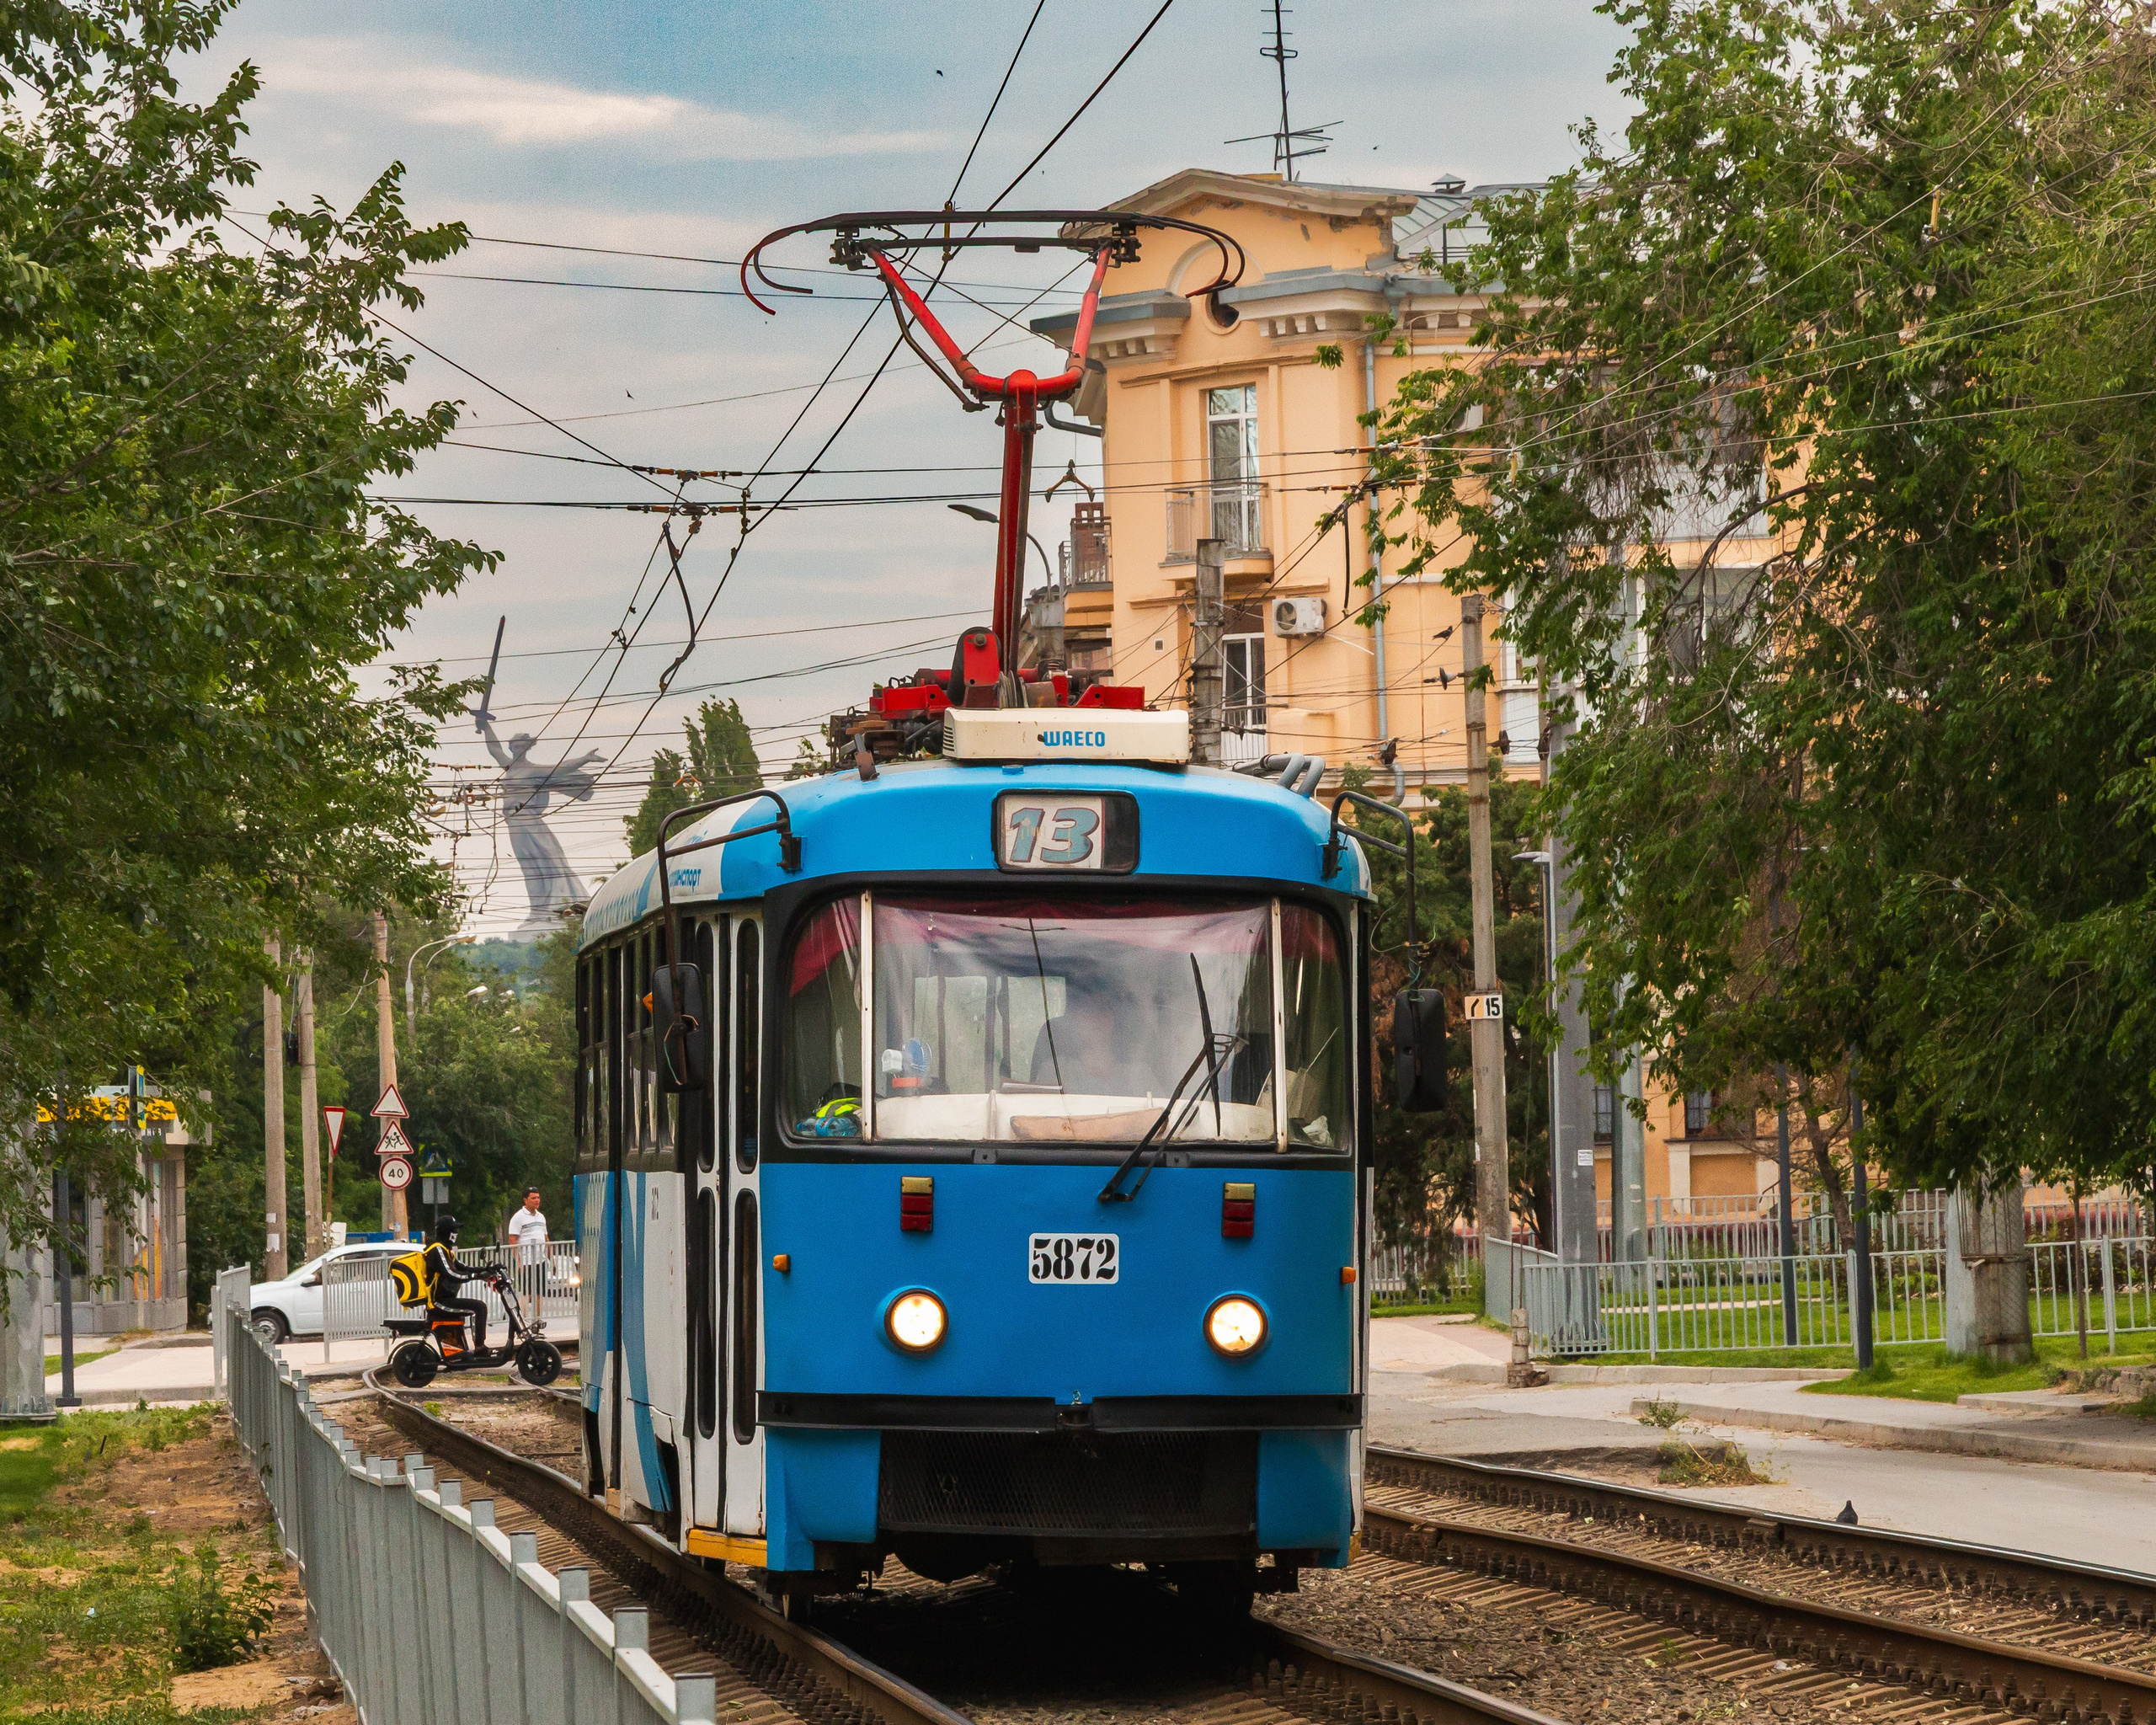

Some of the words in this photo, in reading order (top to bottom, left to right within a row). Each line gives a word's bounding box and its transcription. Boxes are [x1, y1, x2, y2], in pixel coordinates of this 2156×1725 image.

[1043, 730, 1105, 747] WAECO
[1009, 807, 1100, 864] 13
[1486, 997, 1501, 1017] 15
[388, 1167, 404, 1178] 40
[1032, 1237, 1116, 1280] 5872
